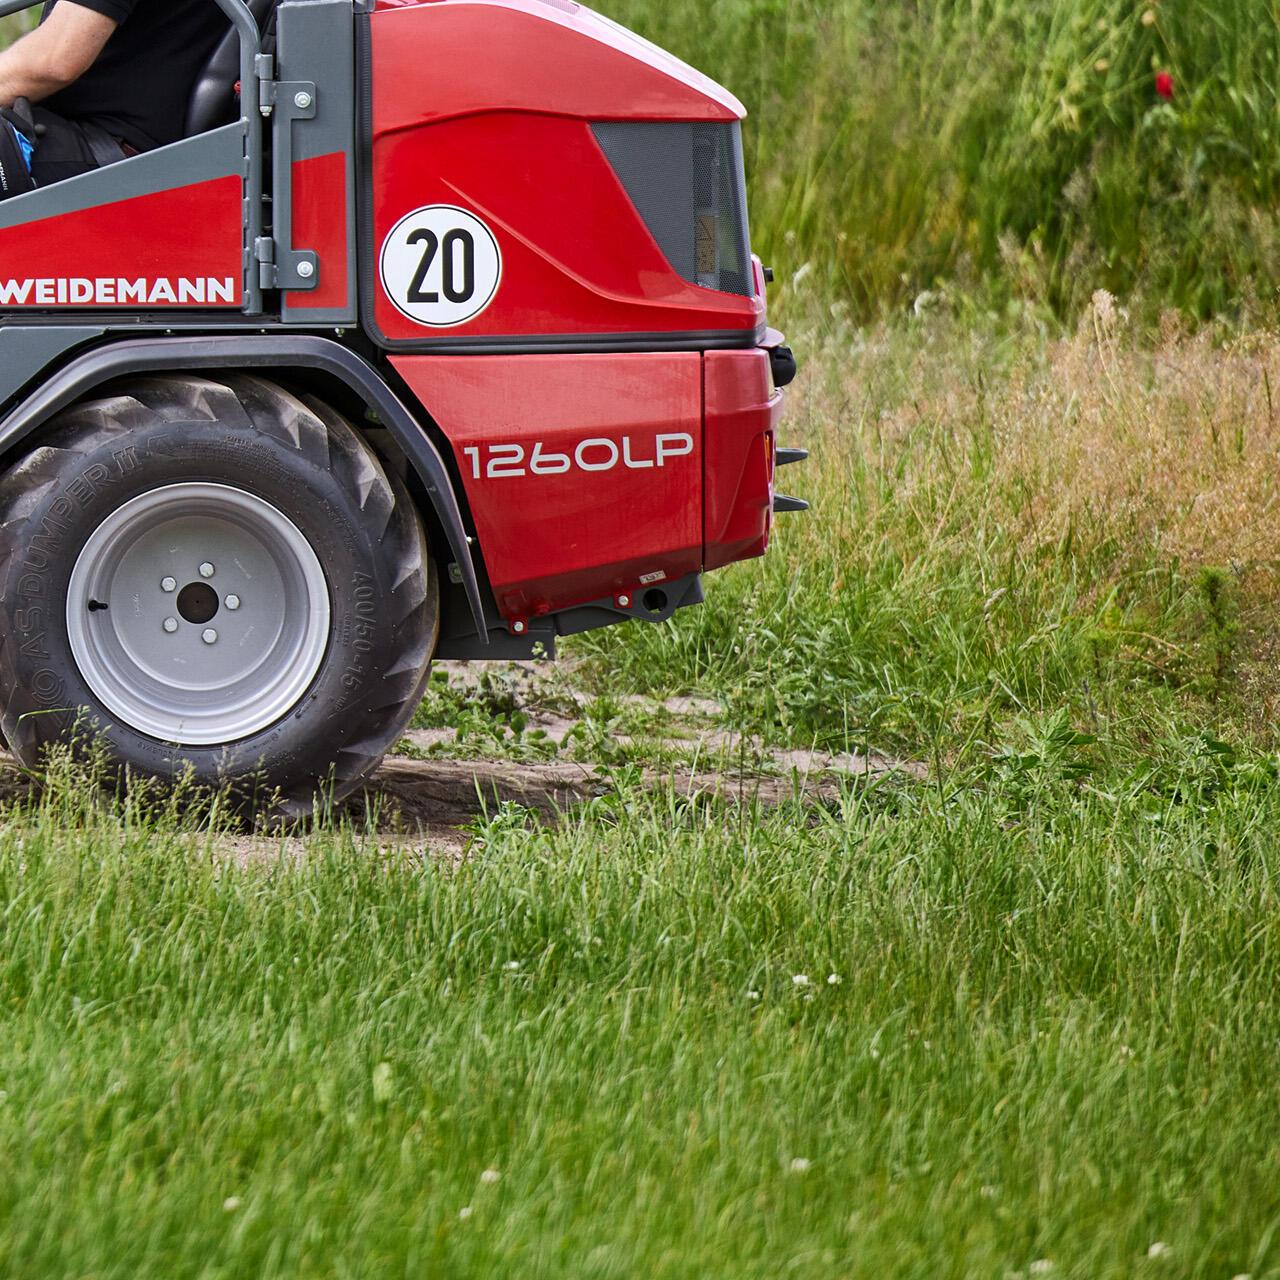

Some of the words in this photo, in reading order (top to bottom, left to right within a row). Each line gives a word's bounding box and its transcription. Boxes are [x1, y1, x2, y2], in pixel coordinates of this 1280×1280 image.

[406, 227, 475, 304] 20
[463, 432, 694, 480] 1260LP
[17, 463, 121, 597] DUMPER
[16, 609, 49, 659] AS
